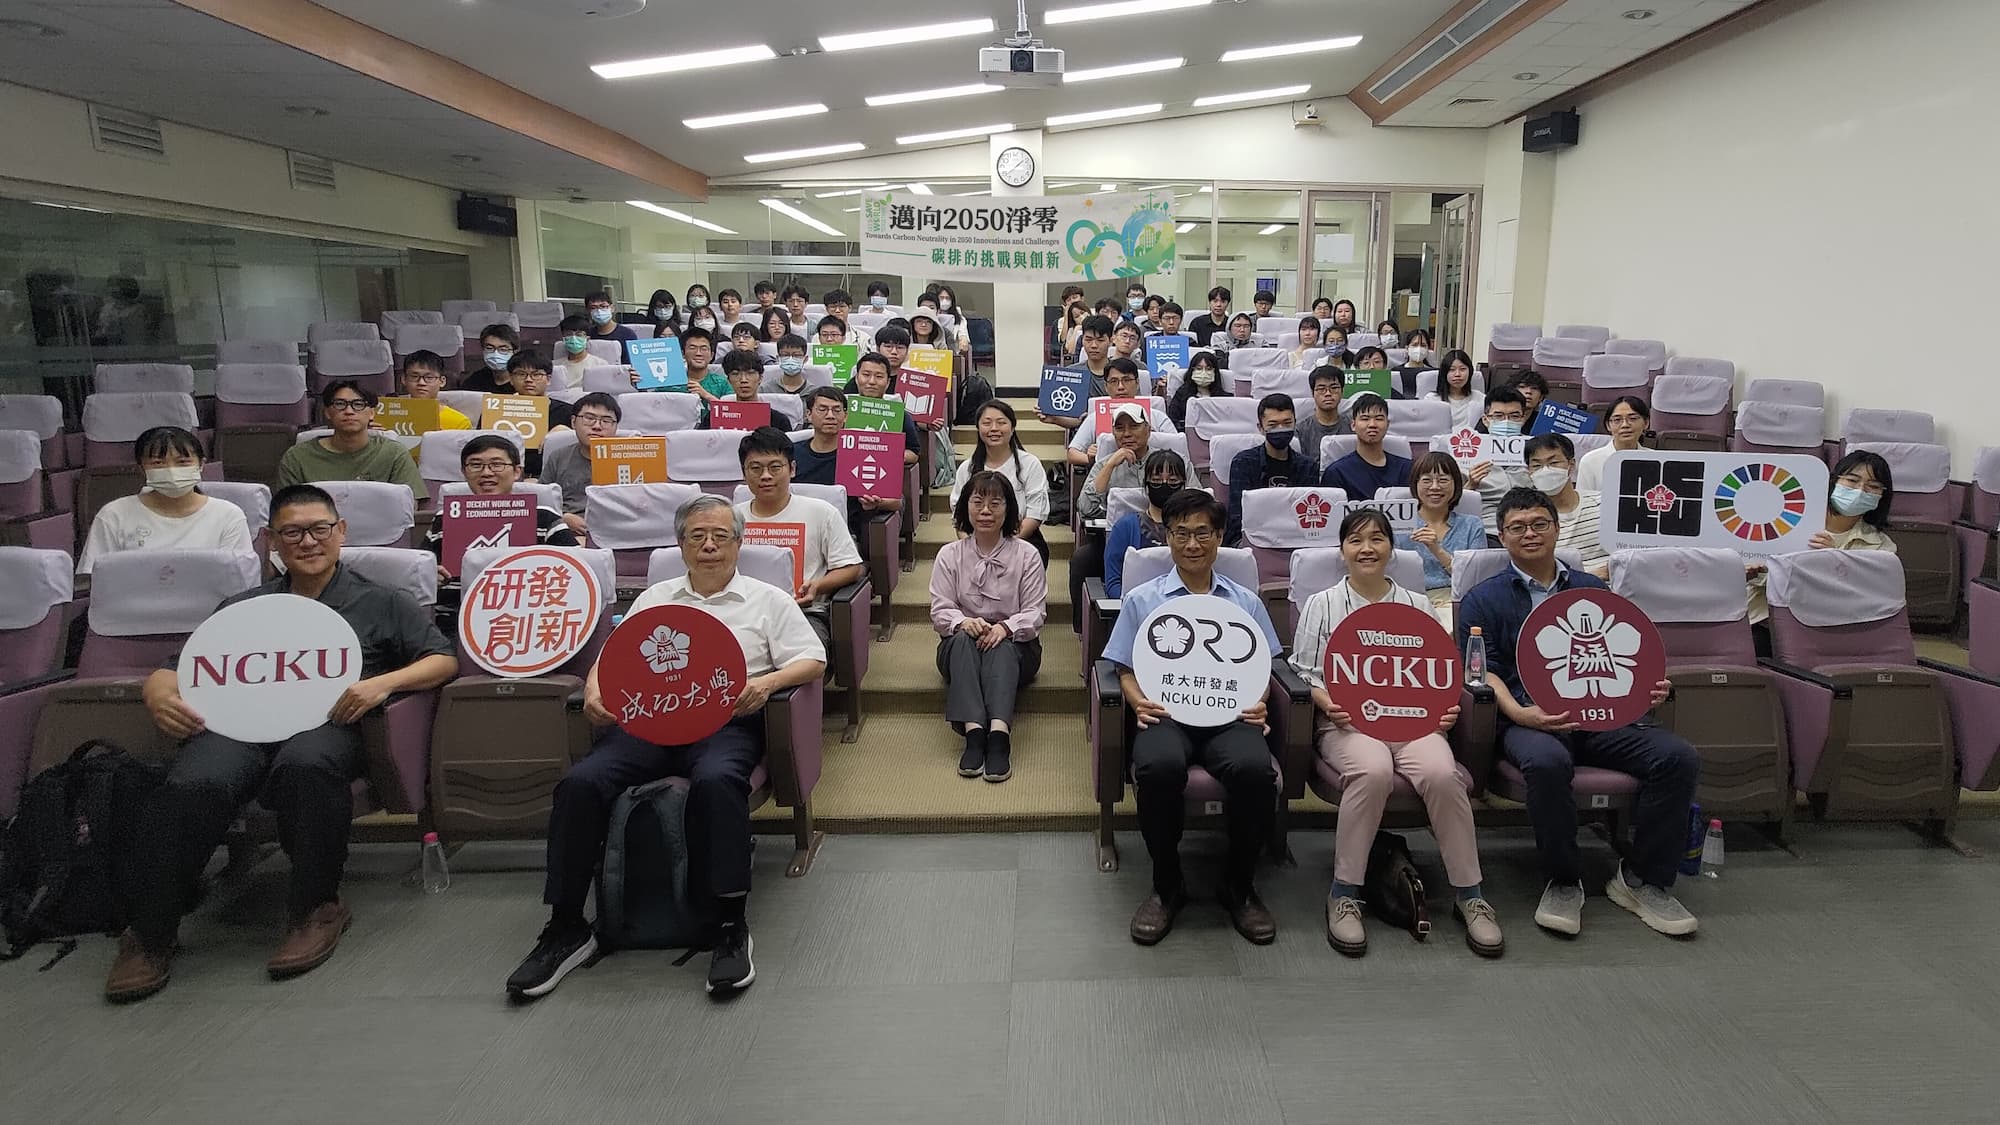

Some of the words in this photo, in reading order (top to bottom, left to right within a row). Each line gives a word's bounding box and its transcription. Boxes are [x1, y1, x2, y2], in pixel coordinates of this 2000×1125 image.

[889, 204, 1058, 234] 邁向2050淨零
[865, 232, 892, 240] Towards
[893, 233, 915, 241] Carbon
[917, 234, 948, 244] Neutrality
[950, 235, 956, 243] in
[973, 237, 1011, 245] Innovations
[1012, 237, 1024, 245] and
[1025, 238, 1060, 247] Challenges
[931, 247, 1060, 270] 碳排的挑戰與創新
[631, 344, 639, 355] 6
[1149, 339, 1157, 349] 14
[815, 347, 824, 358] 15
[900, 372, 907, 384] 4
[1044, 369, 1054, 380] 17
[1344, 373, 1354, 385] 13
[377, 402, 385, 415] 2
[486, 398, 500, 410] 12
[851, 400, 859, 411] 3
[1100, 403, 1106, 414] 5
[713, 405, 720, 418] 1
[1543, 404, 1556, 418] 16
[840, 434, 856, 450] 10
[594, 444, 608, 459] 11
[449, 501, 461, 518] 8
[465, 500, 490, 508] DECENT
[490, 500, 511, 508] WORK
[512, 499, 526, 507] AND
[465, 510, 501, 518] ECONOMIC
[501, 509, 529, 517] GROWTH
[1343, 502, 1415, 521] NKU
[744, 527, 767, 537] DUSTRY,
[767, 528, 800, 536] INNOVATION
[752, 538, 800, 546] INFRASTRUCTURE
[1616, 541, 1629, 549] We
[480, 565, 572, 611] 研發
[483, 608, 583, 664] 創新
[1359, 631, 1423, 647] Welcome
[190, 647, 349, 688] NCKU
[1330, 652, 1455, 690] NCKU
[664, 673, 682, 682] 1931
[1161, 673, 1239, 692] 成大研發處
[1160, 690, 1202, 706] NCKU
[1206, 696, 1238, 709] ORD
[1580, 707, 1615, 721] 1931
